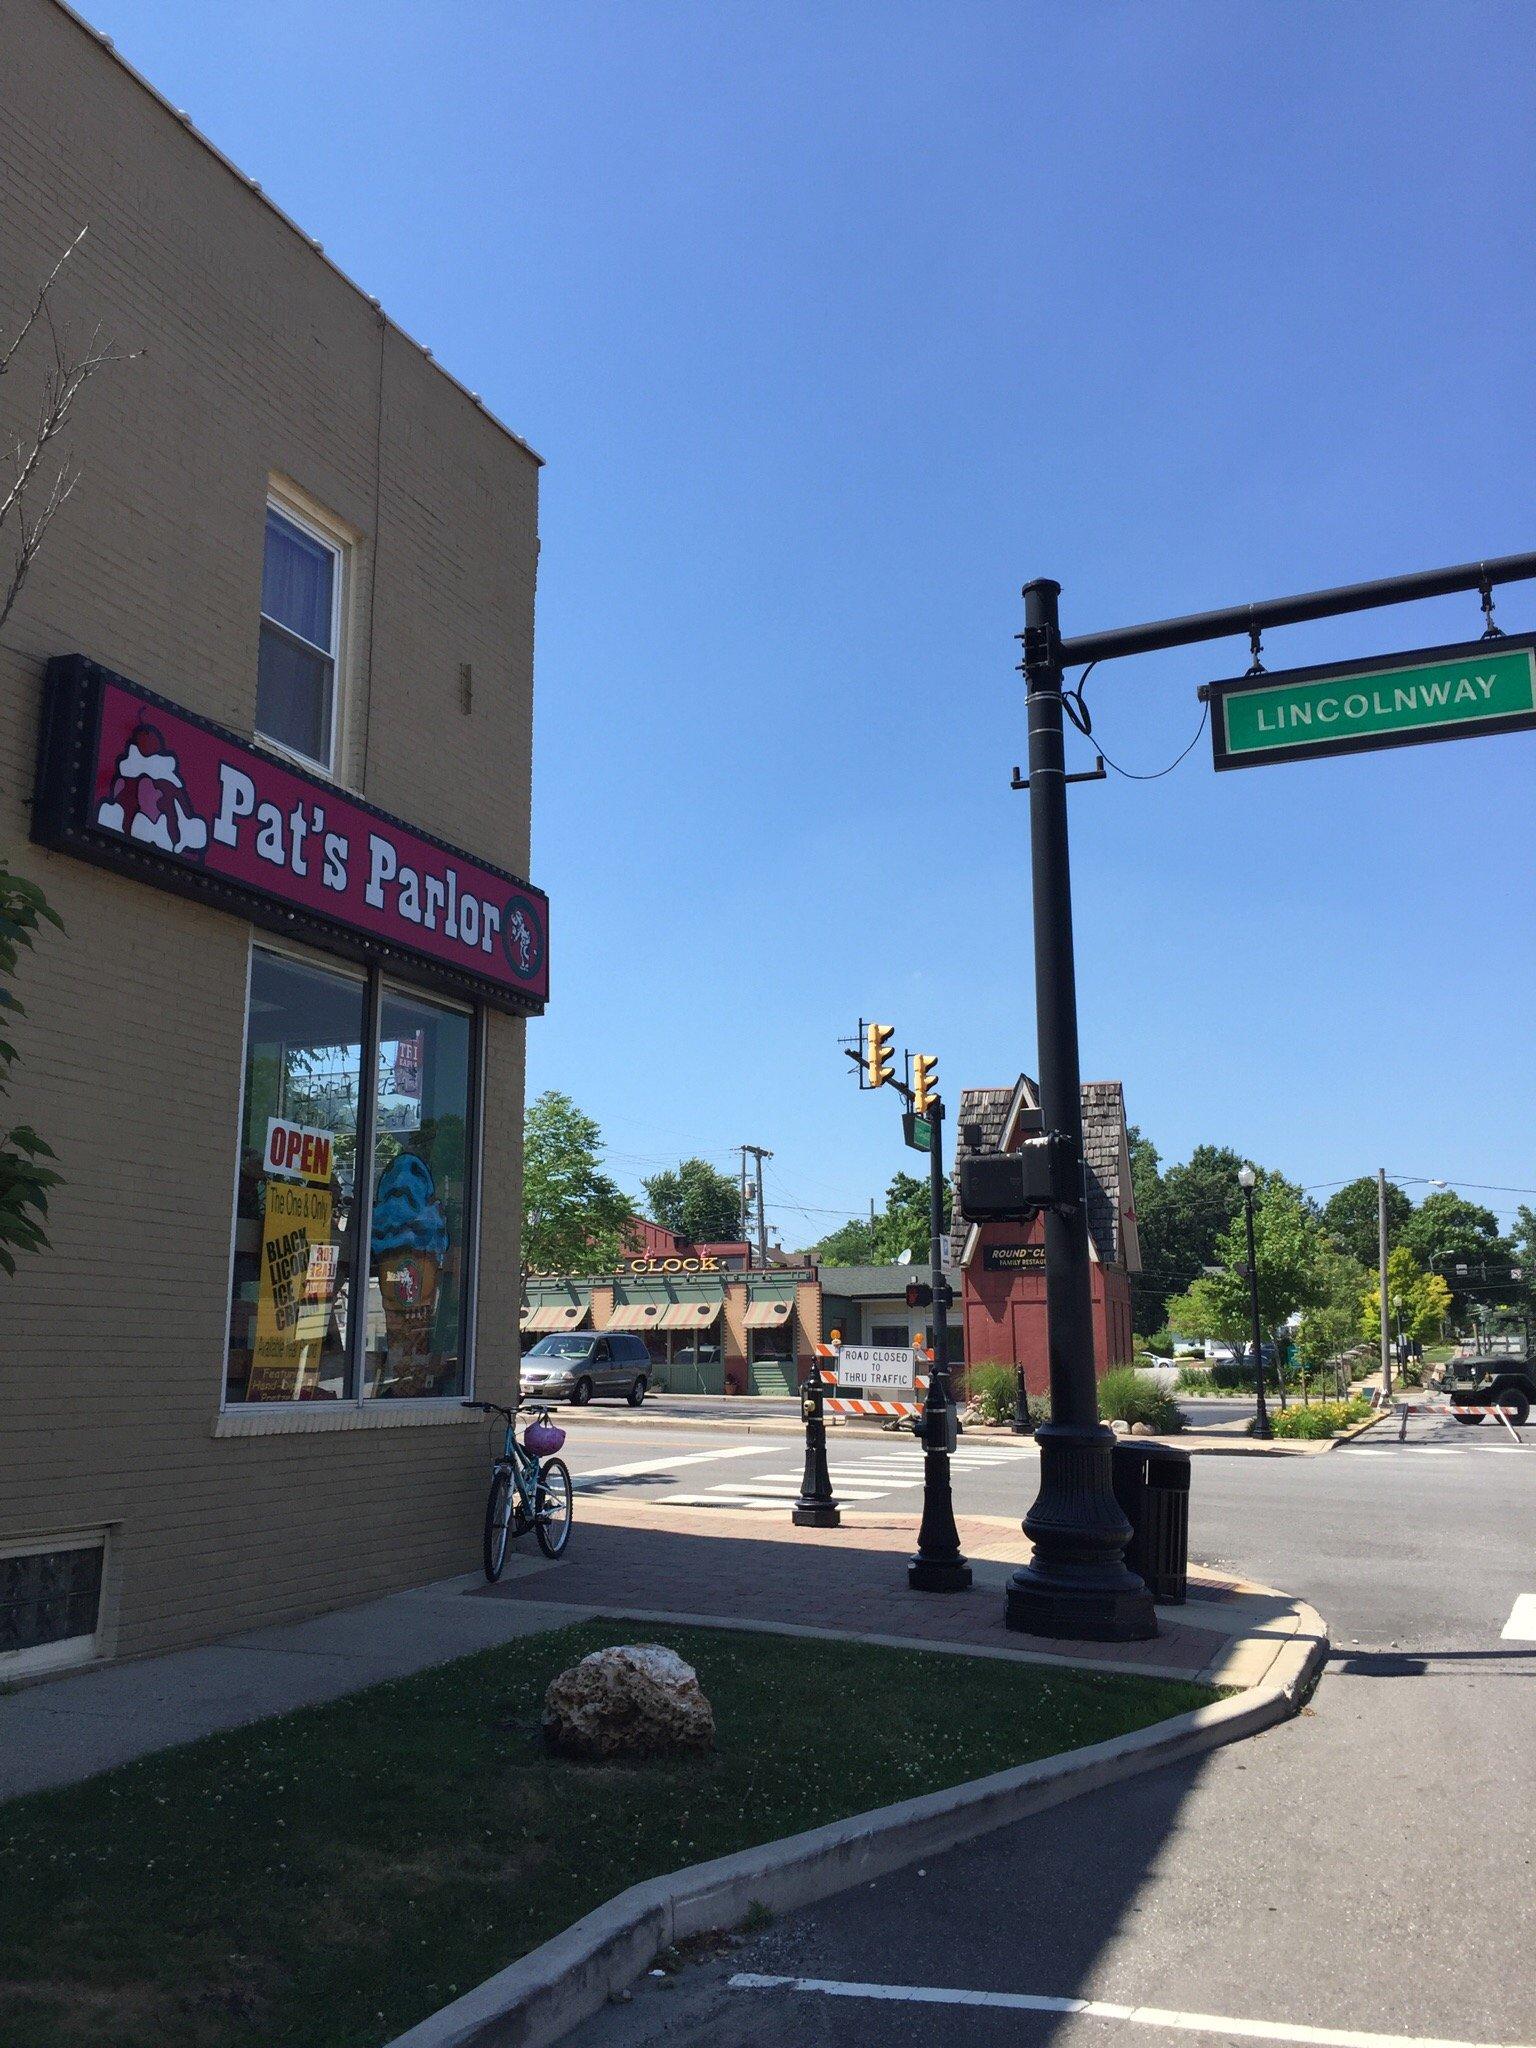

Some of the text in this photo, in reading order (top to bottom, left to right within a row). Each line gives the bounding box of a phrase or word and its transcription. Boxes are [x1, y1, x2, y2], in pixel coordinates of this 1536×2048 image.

[1257, 674, 1497, 731] LINCOLNWAY
[213, 763, 500, 953] Pat's Parlor
[269, 1126, 330, 1176] OPEN
[270, 1187, 329, 1228] The One & Only
[266, 1227, 309, 1263] BLACK
[992, 1249, 1027, 1259] ROUND
[631, 1257, 719, 1272] CLOCK
[272, 1279, 295, 1309] ICE
[845, 1350, 908, 1363] ROAD CLOSED
[872, 1363, 881, 1372] TO
[845, 1372, 908, 1385] THRU TRAFFIC
